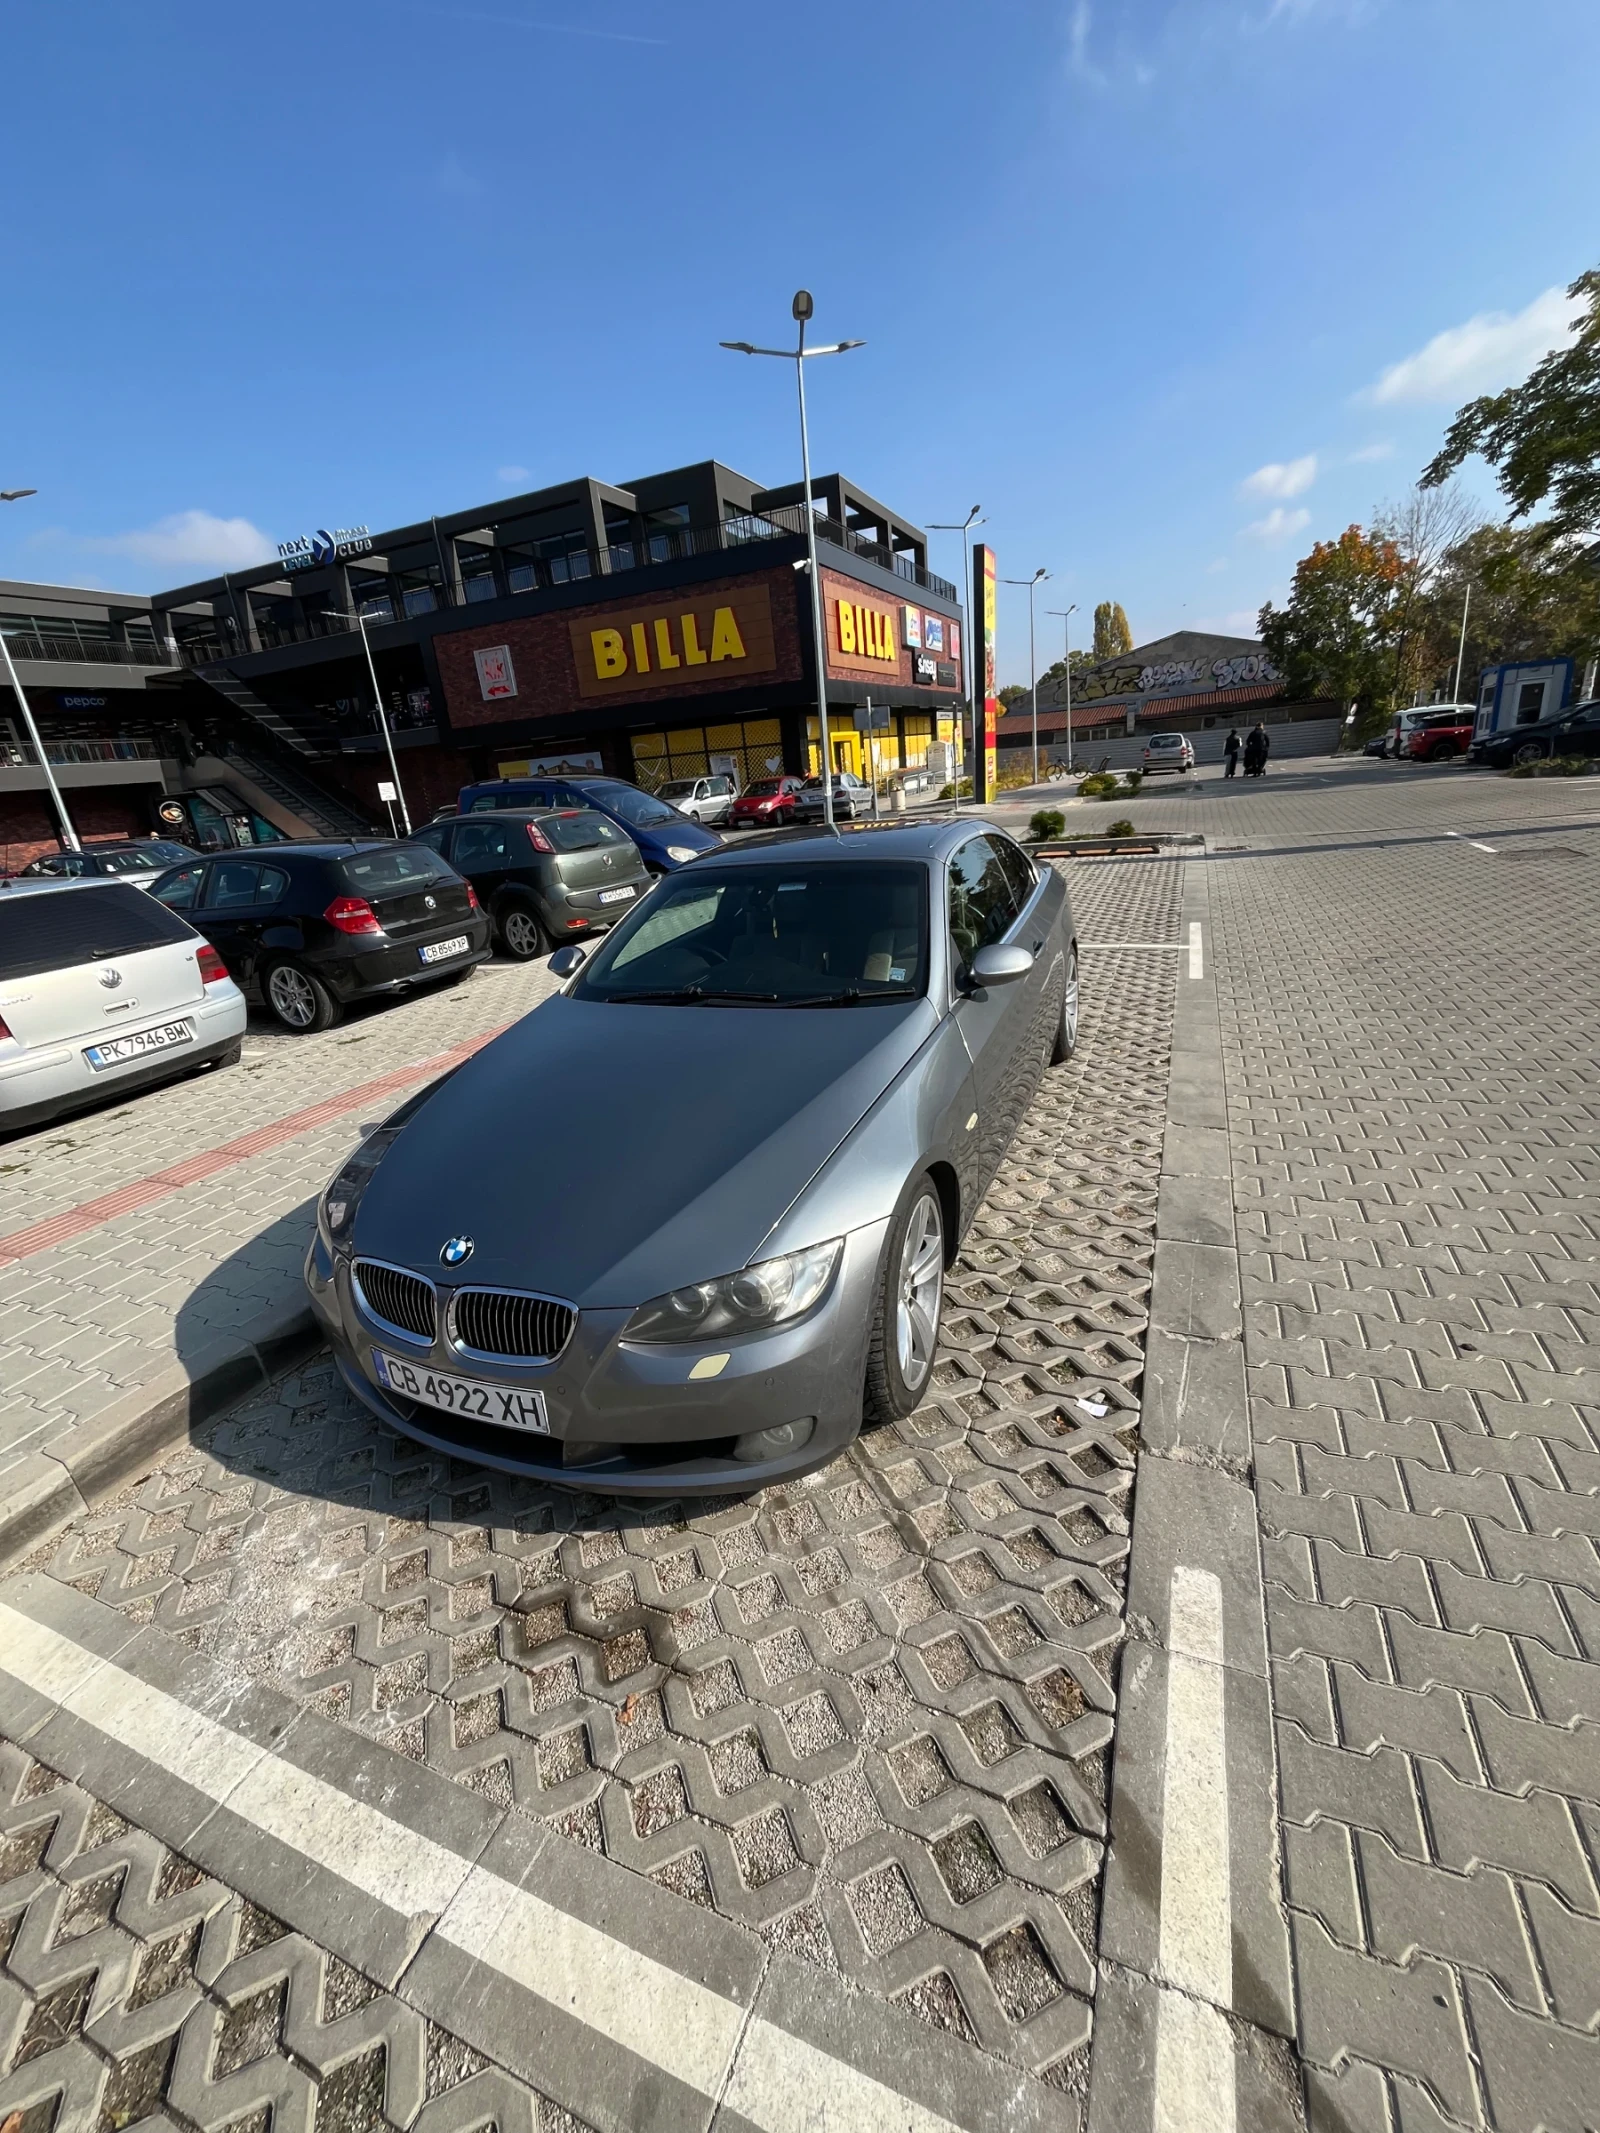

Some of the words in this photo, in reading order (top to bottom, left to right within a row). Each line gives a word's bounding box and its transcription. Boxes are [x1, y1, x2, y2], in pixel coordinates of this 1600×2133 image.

[277, 534, 310, 557] next
[338, 538, 373, 557] CLUB
[282, 549, 315, 572] LEVEL
[836, 599, 896, 661] BILLA
[590, 606, 747, 680] BILLA
[64, 697, 106, 708] pepco
[426, 946, 437, 958] CB
[438, 941, 456, 955] 8569
[456, 937, 466, 949] XP
[99, 1042, 126, 1062] PK
[124, 1030, 165, 1055] 7946
[163, 1023, 188, 1042] BM
[387, 1360, 421, 1396] CB
[424, 1375, 494, 1420] 4922
[494, 1391, 542, 1427] XH
